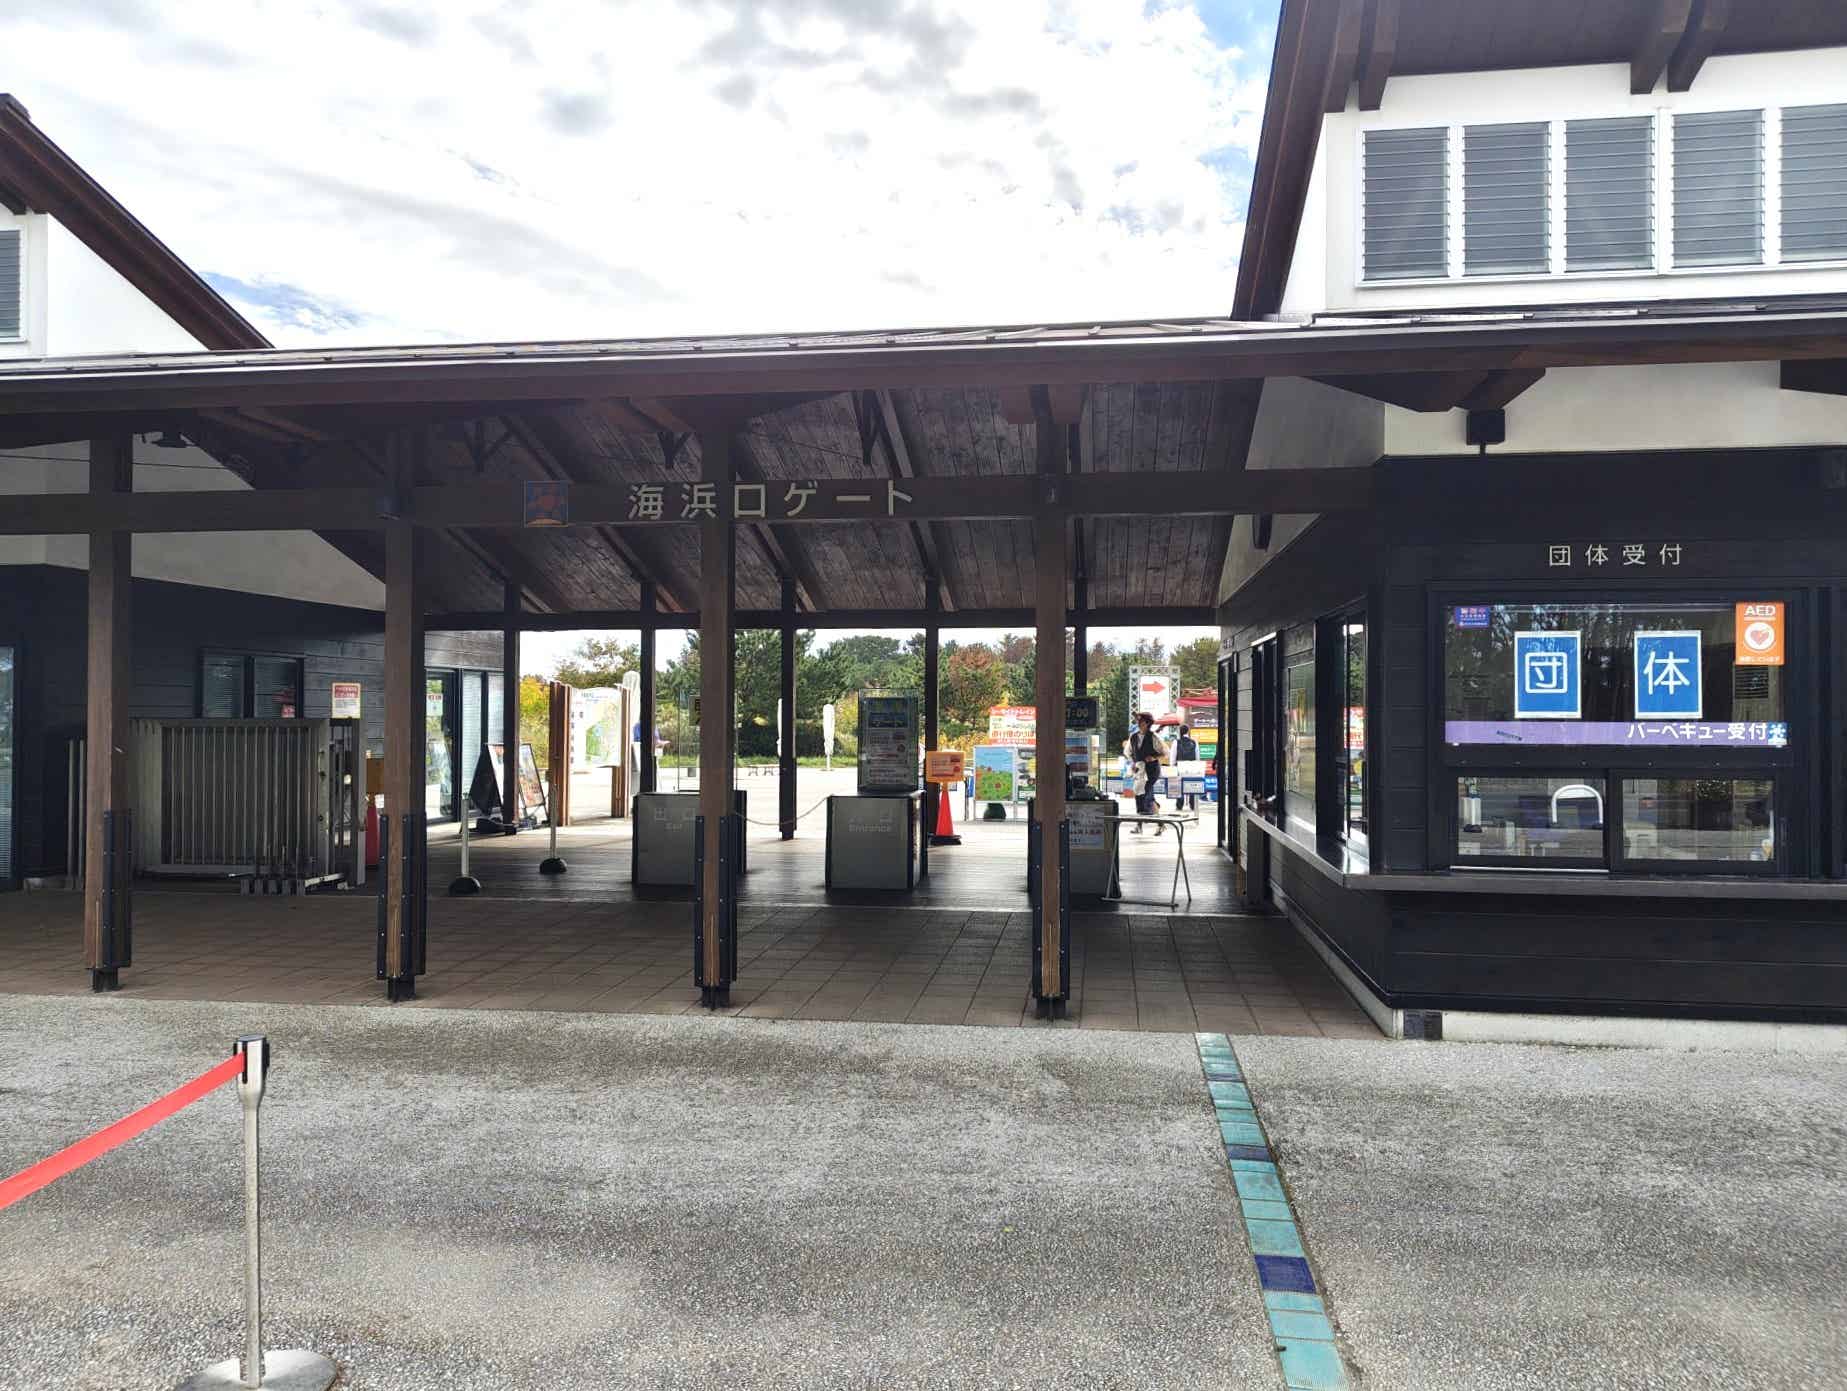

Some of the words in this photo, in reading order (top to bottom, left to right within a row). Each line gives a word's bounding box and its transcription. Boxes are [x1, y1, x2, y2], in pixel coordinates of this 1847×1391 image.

[628, 480, 913, 520] 海浜口ゲート
[1549, 543, 1683, 567] 団体受付
[1743, 604, 1777, 617] AED
[1524, 652, 1569, 694] 団
[1643, 651, 1691, 696] 体
[1627, 722, 1767, 741] バーベキュー受付
